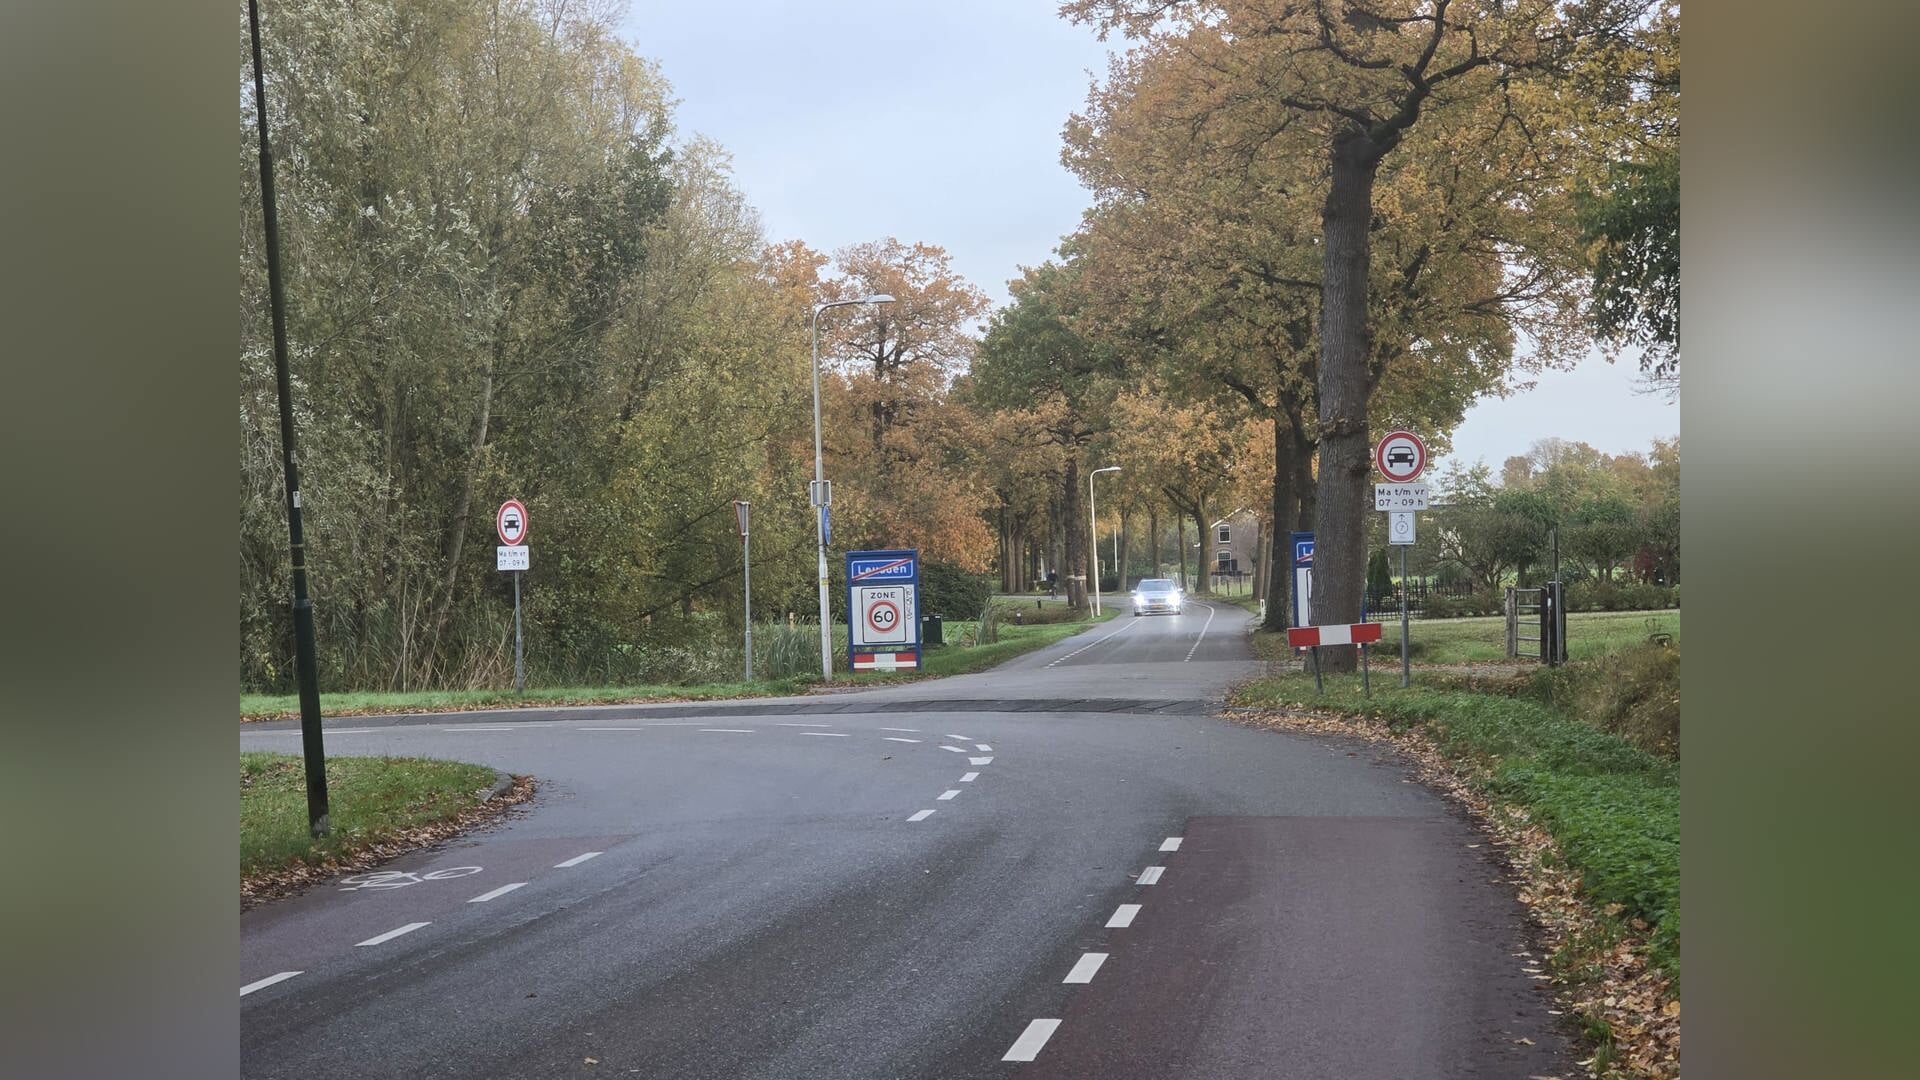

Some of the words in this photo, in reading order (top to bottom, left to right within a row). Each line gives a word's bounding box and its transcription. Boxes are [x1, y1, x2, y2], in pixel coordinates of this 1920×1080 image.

[1378, 488, 1391, 496] Ma
[1394, 488, 1411, 496] t/m
[1378, 498, 1391, 506] 07
[1401, 498, 1414, 506] 09
[873, 610, 894, 623] 60
